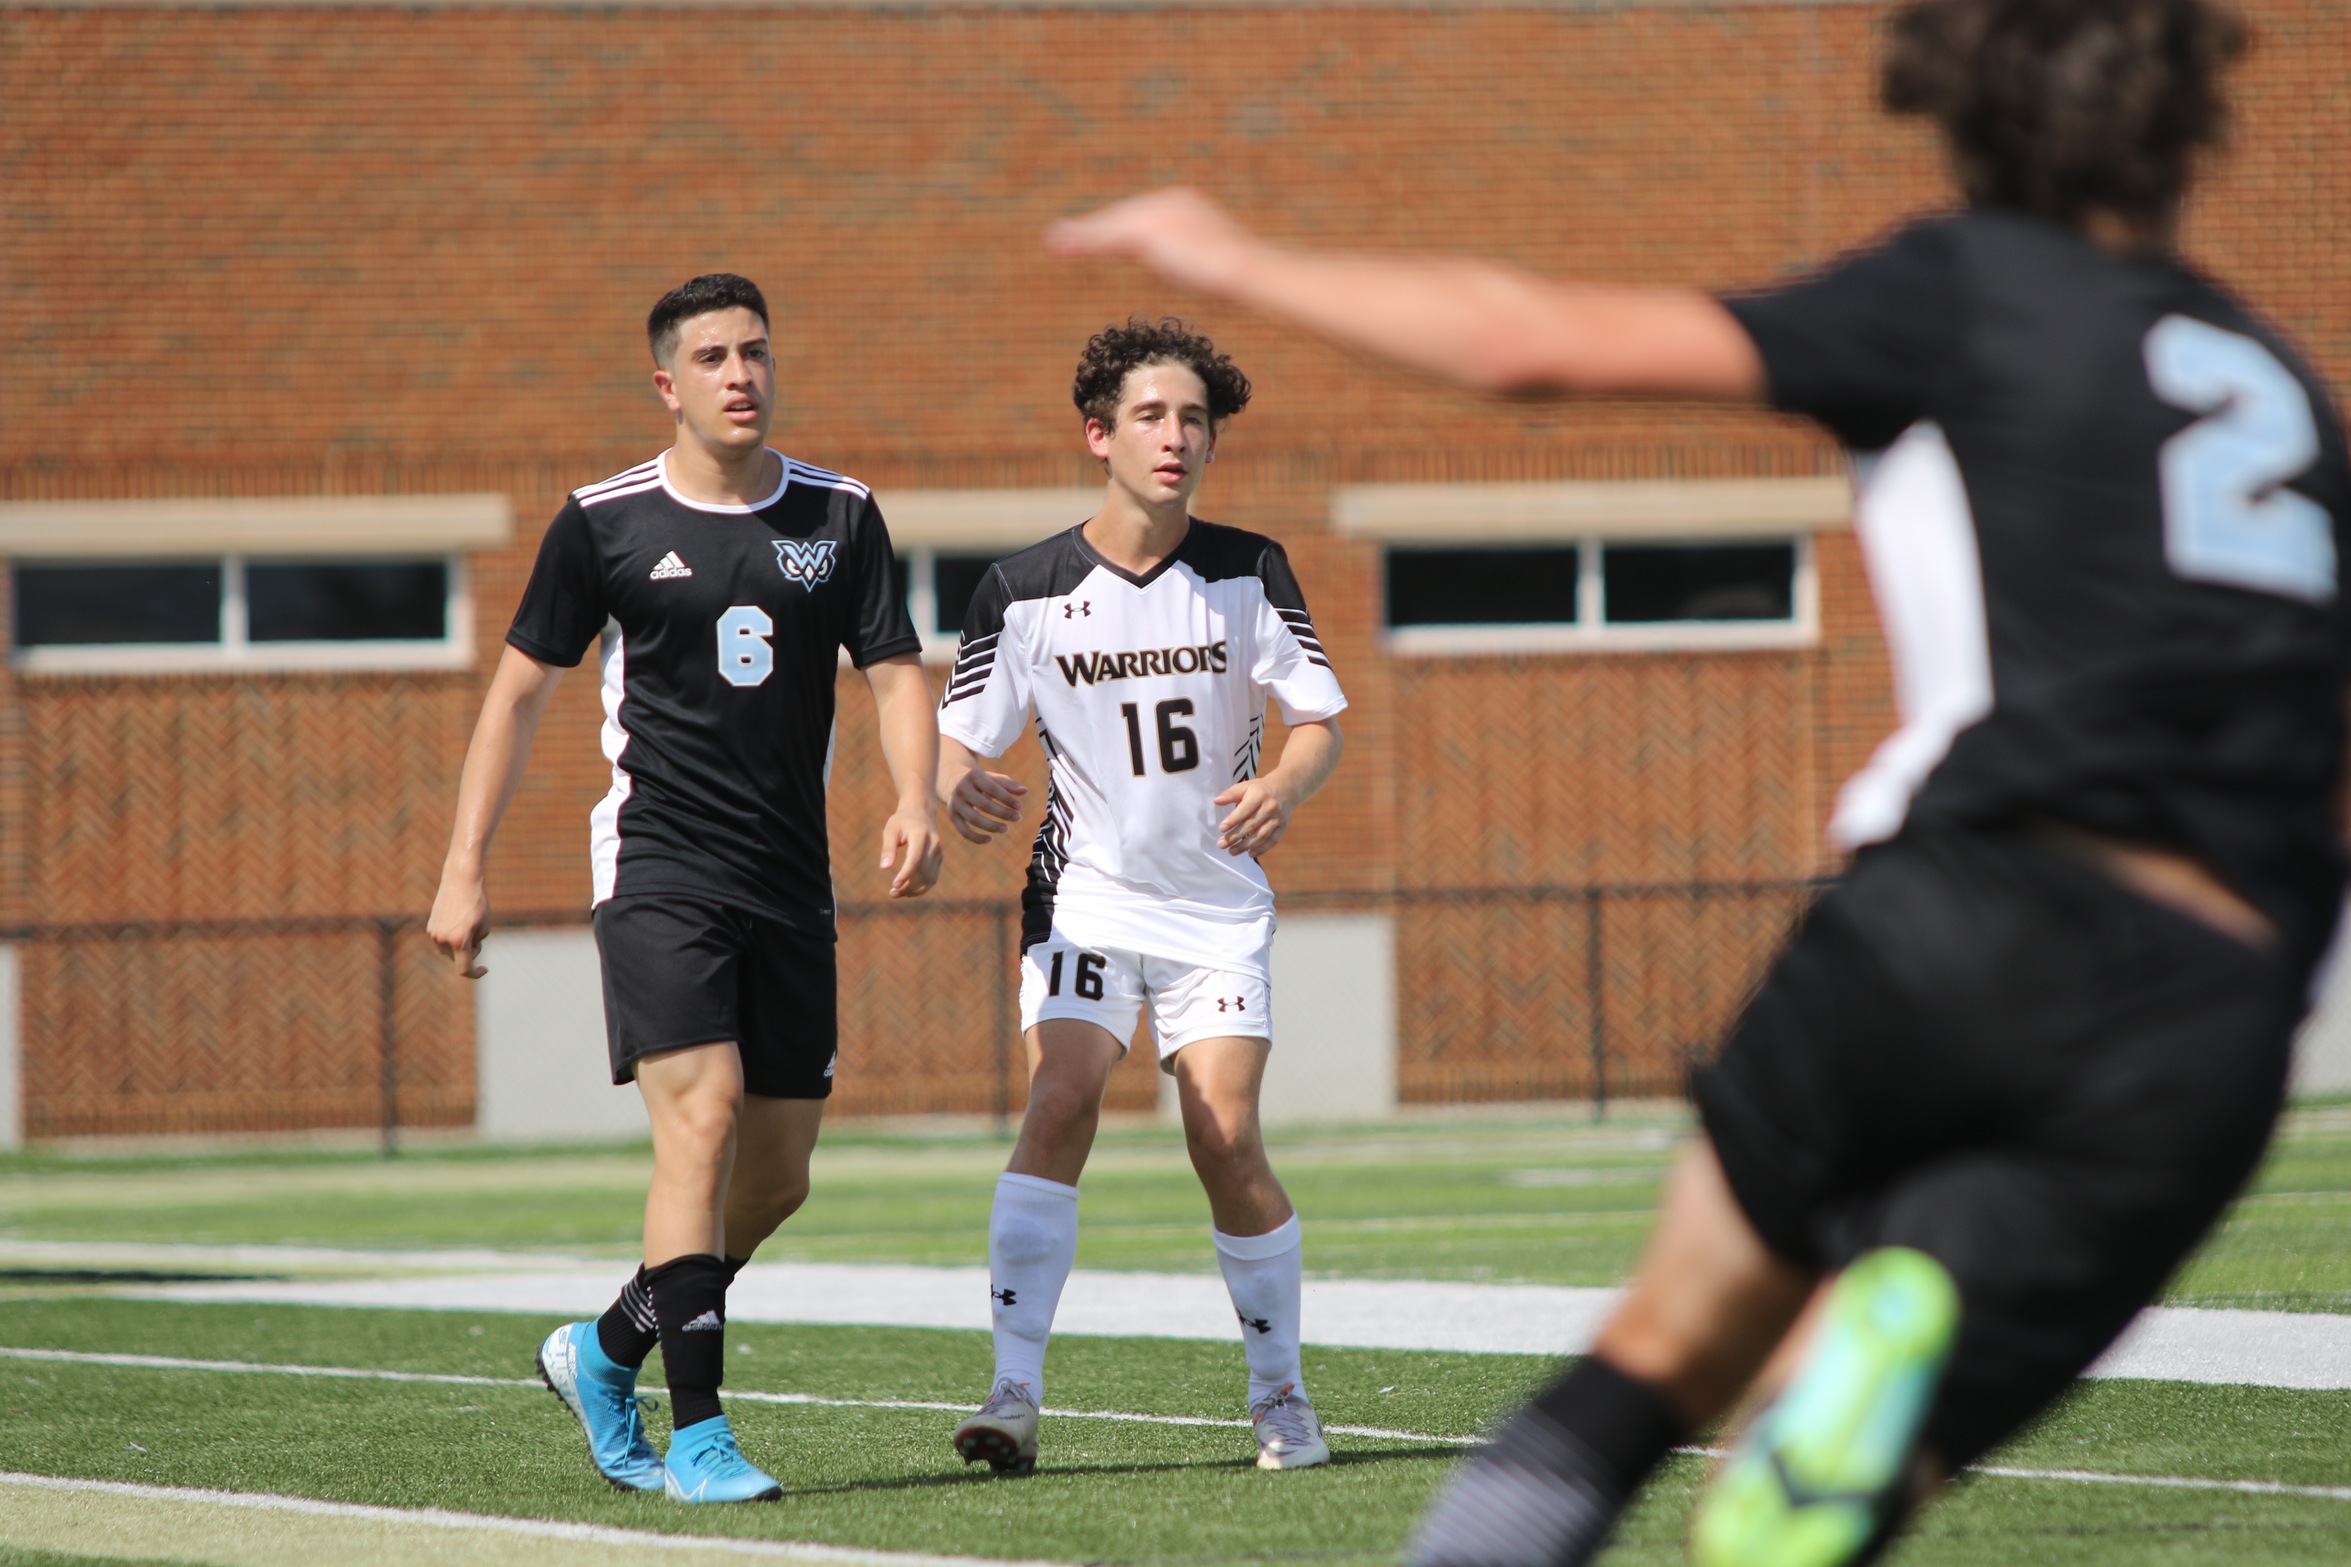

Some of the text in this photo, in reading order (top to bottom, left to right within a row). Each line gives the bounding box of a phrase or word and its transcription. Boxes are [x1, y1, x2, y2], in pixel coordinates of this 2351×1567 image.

[2142, 313, 2338, 604] 2
[650, 567, 692, 580] adidas
[716, 605, 773, 686] 6
[1055, 640, 1227, 688] WARRIORS
[1121, 698, 1199, 776] 16
[1048, 951, 1106, 1001] 16
